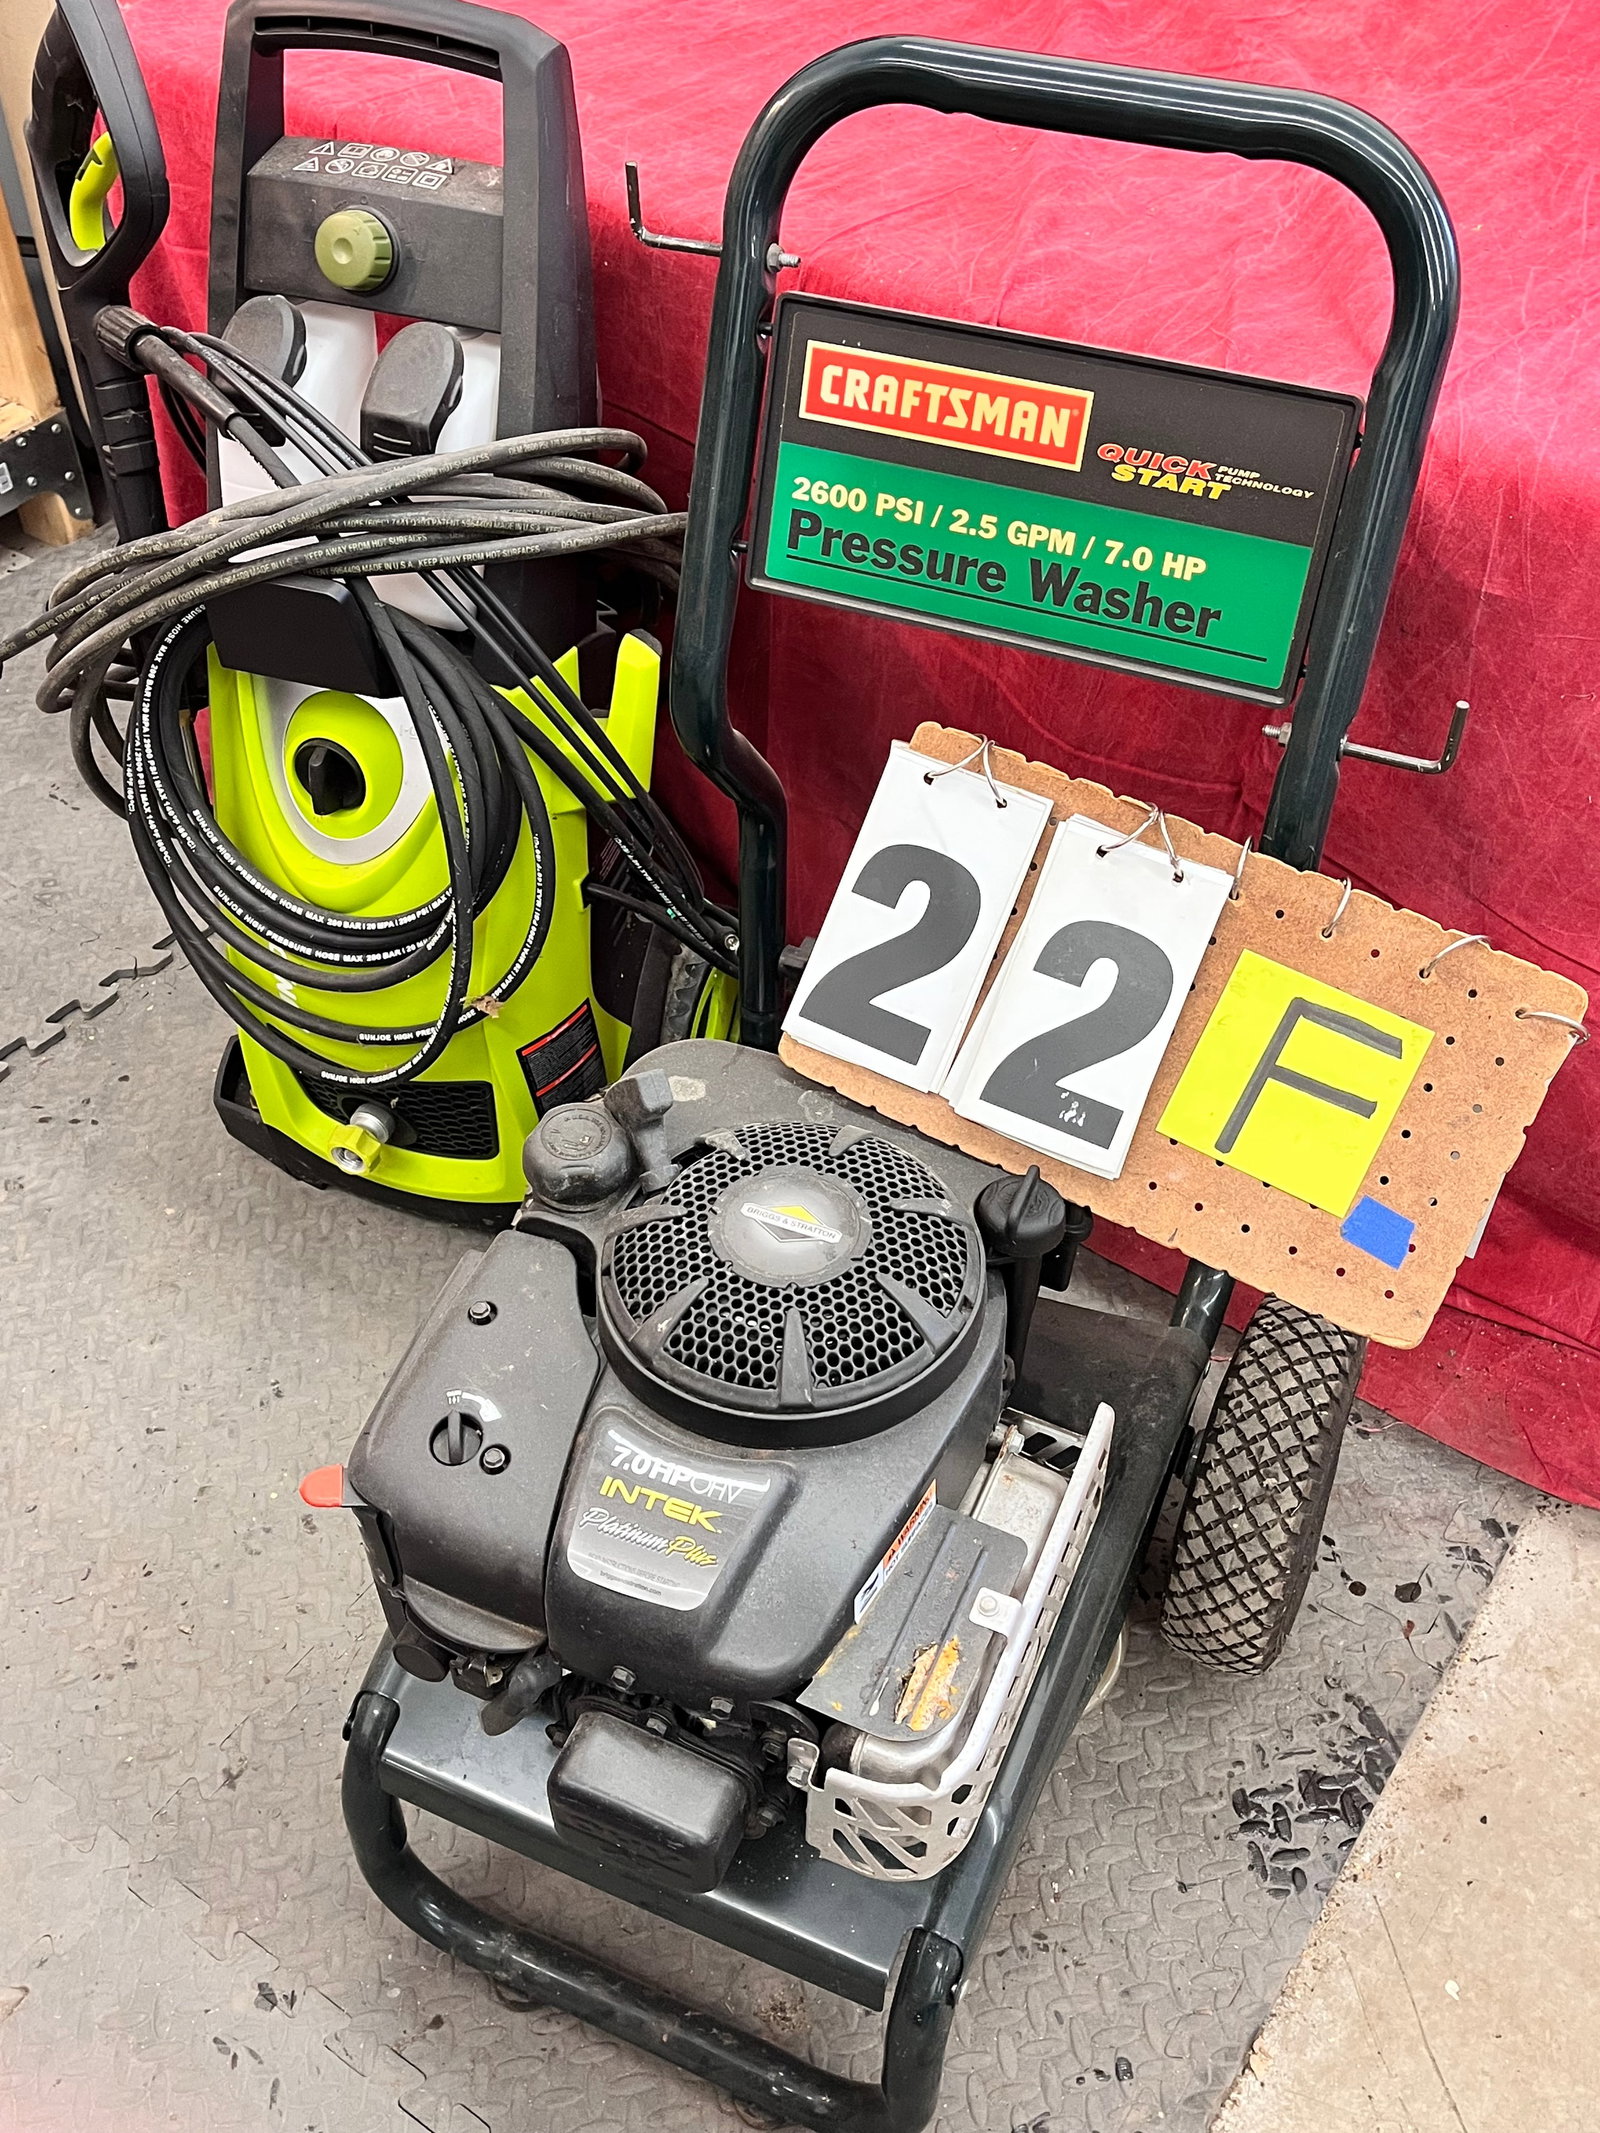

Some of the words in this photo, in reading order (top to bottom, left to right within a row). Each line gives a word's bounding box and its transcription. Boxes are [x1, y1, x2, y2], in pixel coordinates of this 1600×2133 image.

[1097, 443, 1217, 480] QUICK
[1217, 465, 1261, 480] PUMP
[1111, 463, 1232, 500] START
[1213, 474, 1315, 499] TECHNOLOGY
[258, 519, 287, 537] PATENT
[791, 477, 868, 513] 2600
[875, 494, 924, 524] PSI
[949, 508, 998, 540] 2.5
[1007, 519, 1075, 556] GPM
[1104, 540, 1154, 572] 7.0
[1161, 552, 1207, 581] HP
[302, 549, 324, 562] KEEP
[324, 544, 348, 557] AWAY
[347, 540, 371, 552] FROM
[370, 537, 388, 548] HOT
[388, 531, 428, 546] SURFACES
[361, 562, 384, 573] MADE
[417, 557, 437, 567] KEEP
[437, 554, 462, 565] AWAY
[461, 551, 485, 562] FROM
[484, 549, 502, 559] HOT
[500, 543, 541, 557] SURFACES
[788, 510, 1007, 594] Pressure
[1029, 558, 1222, 638] Washer
[164, 623, 183, 644] HOSE
[153, 644, 168, 663] MAX
[147, 663, 159, 679] 200
[143, 678, 155, 698] BAR
[142, 701, 150, 713] 20
[141, 713, 150, 734] MPA
[143, 737, 154, 760] 2900
[147, 759, 159, 776] PSI
[153, 779, 168, 801] MAX
[140, 793, 152, 814] MAX
[192, 808, 219, 844] SUNJOE
[215, 843, 238, 866] HIGH
[234, 862, 280, 901] PRESSURE
[278, 896, 305, 916] HOSE
[304, 908, 327, 924] MAX
[342, 920, 362, 930] BAR
[365, 922, 376, 931] 20
[376, 920, 395, 930] MPA
[212, 885, 244, 916] SUNJOE
[243, 913, 266, 933] HIGH
[265, 929, 313, 956] PRESSURE
[314, 949, 341, 962] HOSE
[342, 954, 364, 963] MAX
[381, 948, 402, 960] BAR
[500, 974, 515, 990] BAR
[512, 962, 522, 974] 20
[517, 947, 530, 965] MPA
[535, 888, 543, 908] MAX
[358, 1033, 392, 1042] SUNJOE
[393, 1032, 414, 1041] HIGH
[1215, 997, 1402, 1154] F
[746, 1206, 781, 1221] BRIGGS
[790, 1220, 837, 1239] STRATTON
[599, 1475, 722, 1532] INTEK
[579, 1507, 671, 1552] Platinum
[667, 1535, 718, 1567] Plus
